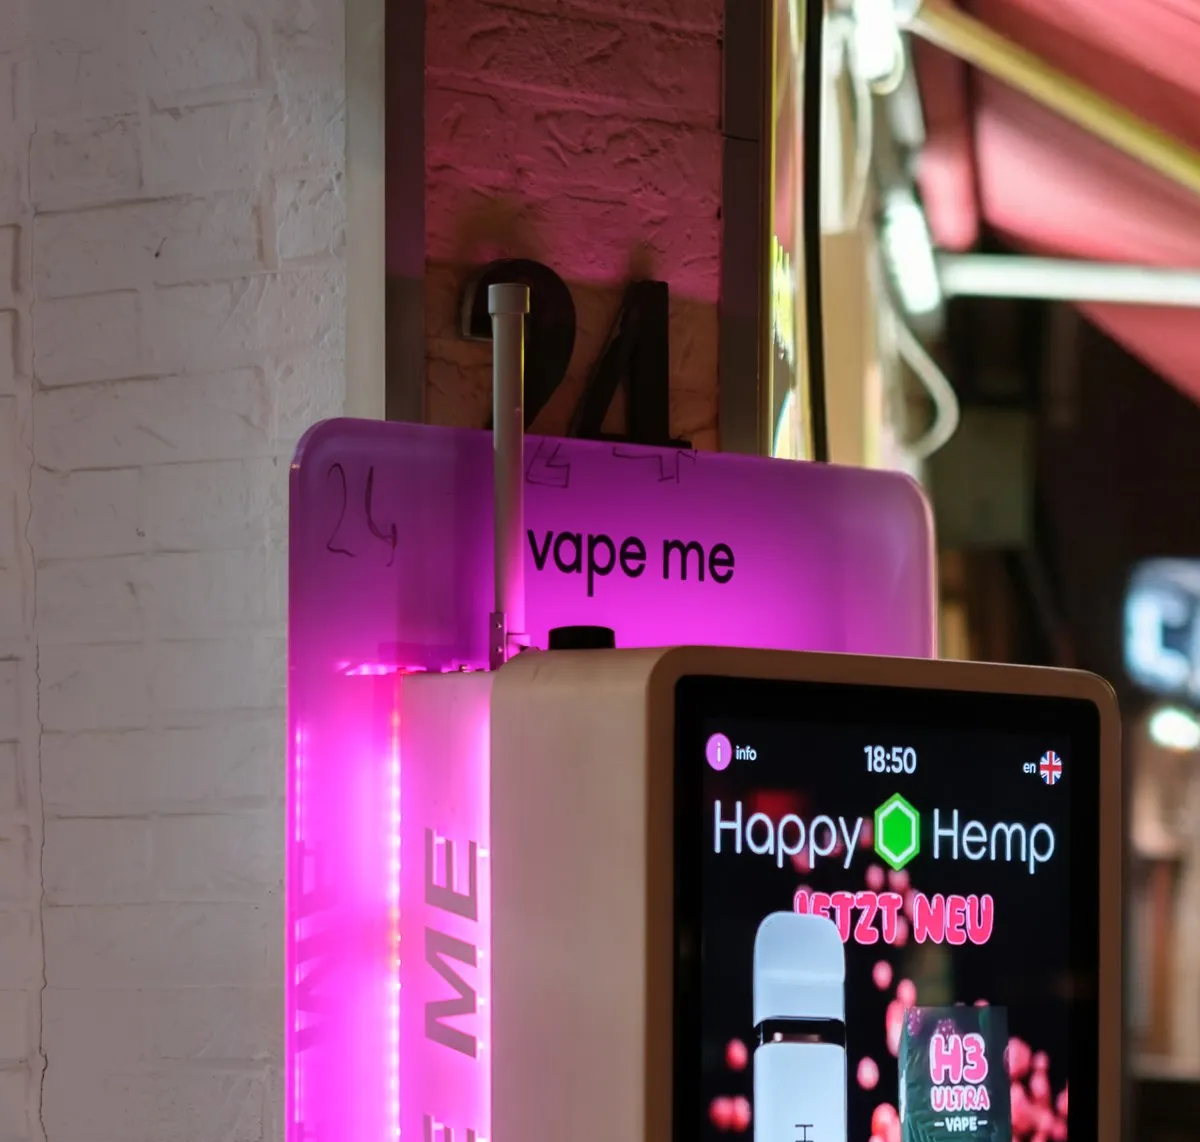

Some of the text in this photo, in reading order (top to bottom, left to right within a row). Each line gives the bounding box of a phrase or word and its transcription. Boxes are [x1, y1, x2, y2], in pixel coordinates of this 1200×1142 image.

[526, 528, 735, 597] vape me
[735, 745, 758, 762] info
[863, 745, 917, 774] 18:50
[1022, 762, 1037, 774] en
[713, 800, 1055, 874] Happy Hemp
[423, 828, 480, 1059] ME
[912, 892, 994, 945] NEU
[930, 1033, 989, 1085] H3
[931, 1085, 990, 1111] ULTRA
